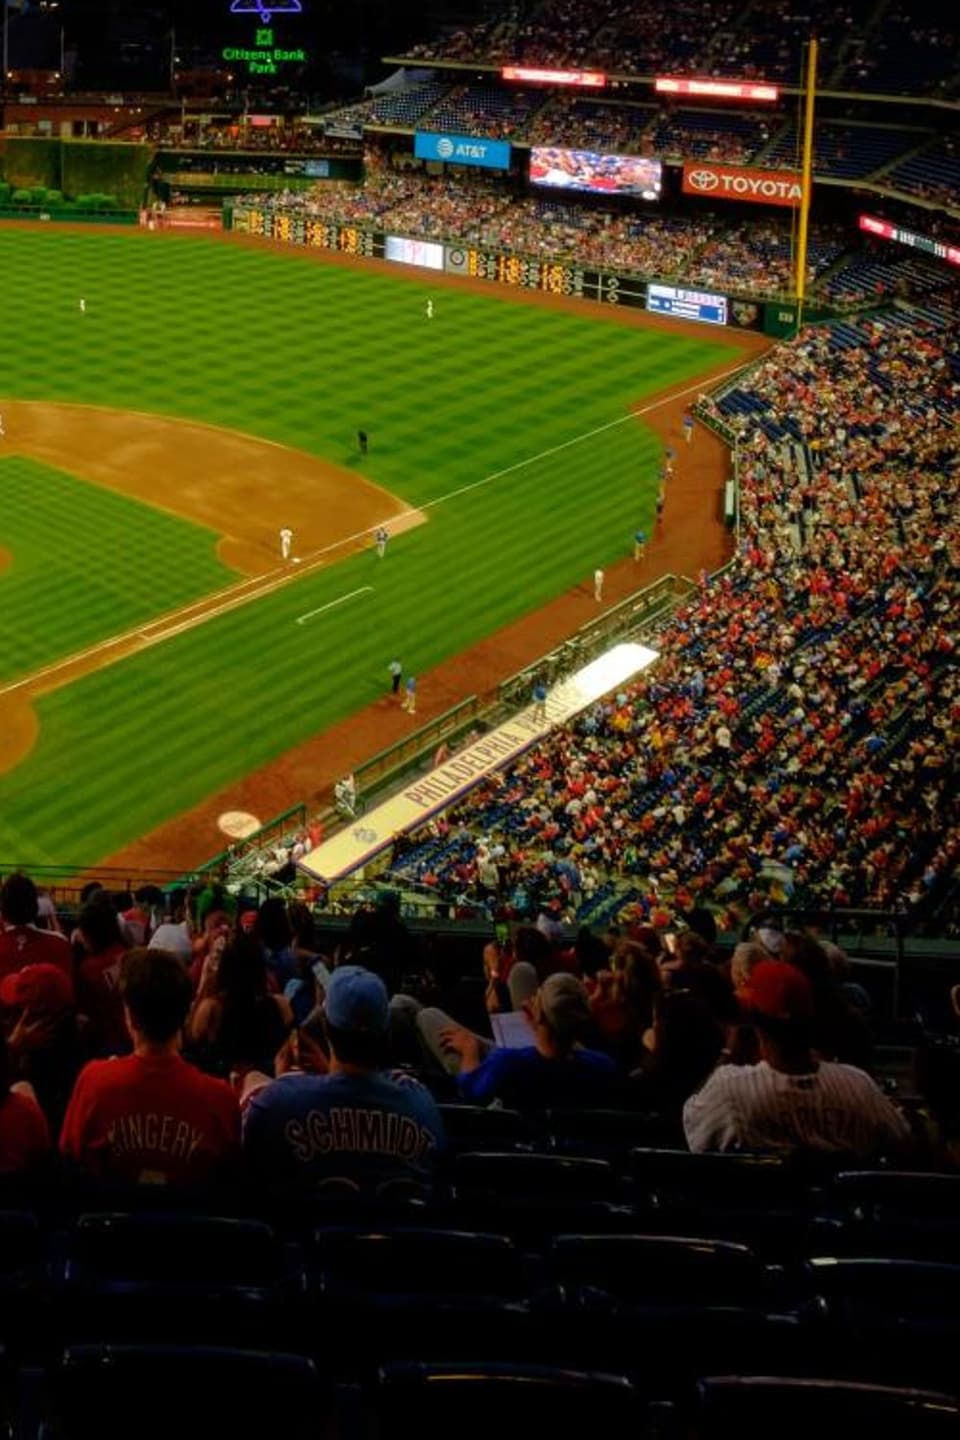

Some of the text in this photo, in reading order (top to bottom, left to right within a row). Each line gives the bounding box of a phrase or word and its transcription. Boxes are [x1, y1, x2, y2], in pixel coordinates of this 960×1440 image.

[222, 47, 305, 61] Citizens Bank
[249, 61, 277, 73] Park
[456, 144, 487, 159] AT&T
[722, 175, 803, 199] TOYOTA
[404, 730, 525, 808] PHILADELPHIA
[284, 1105, 437, 1165] SCHMIDT
